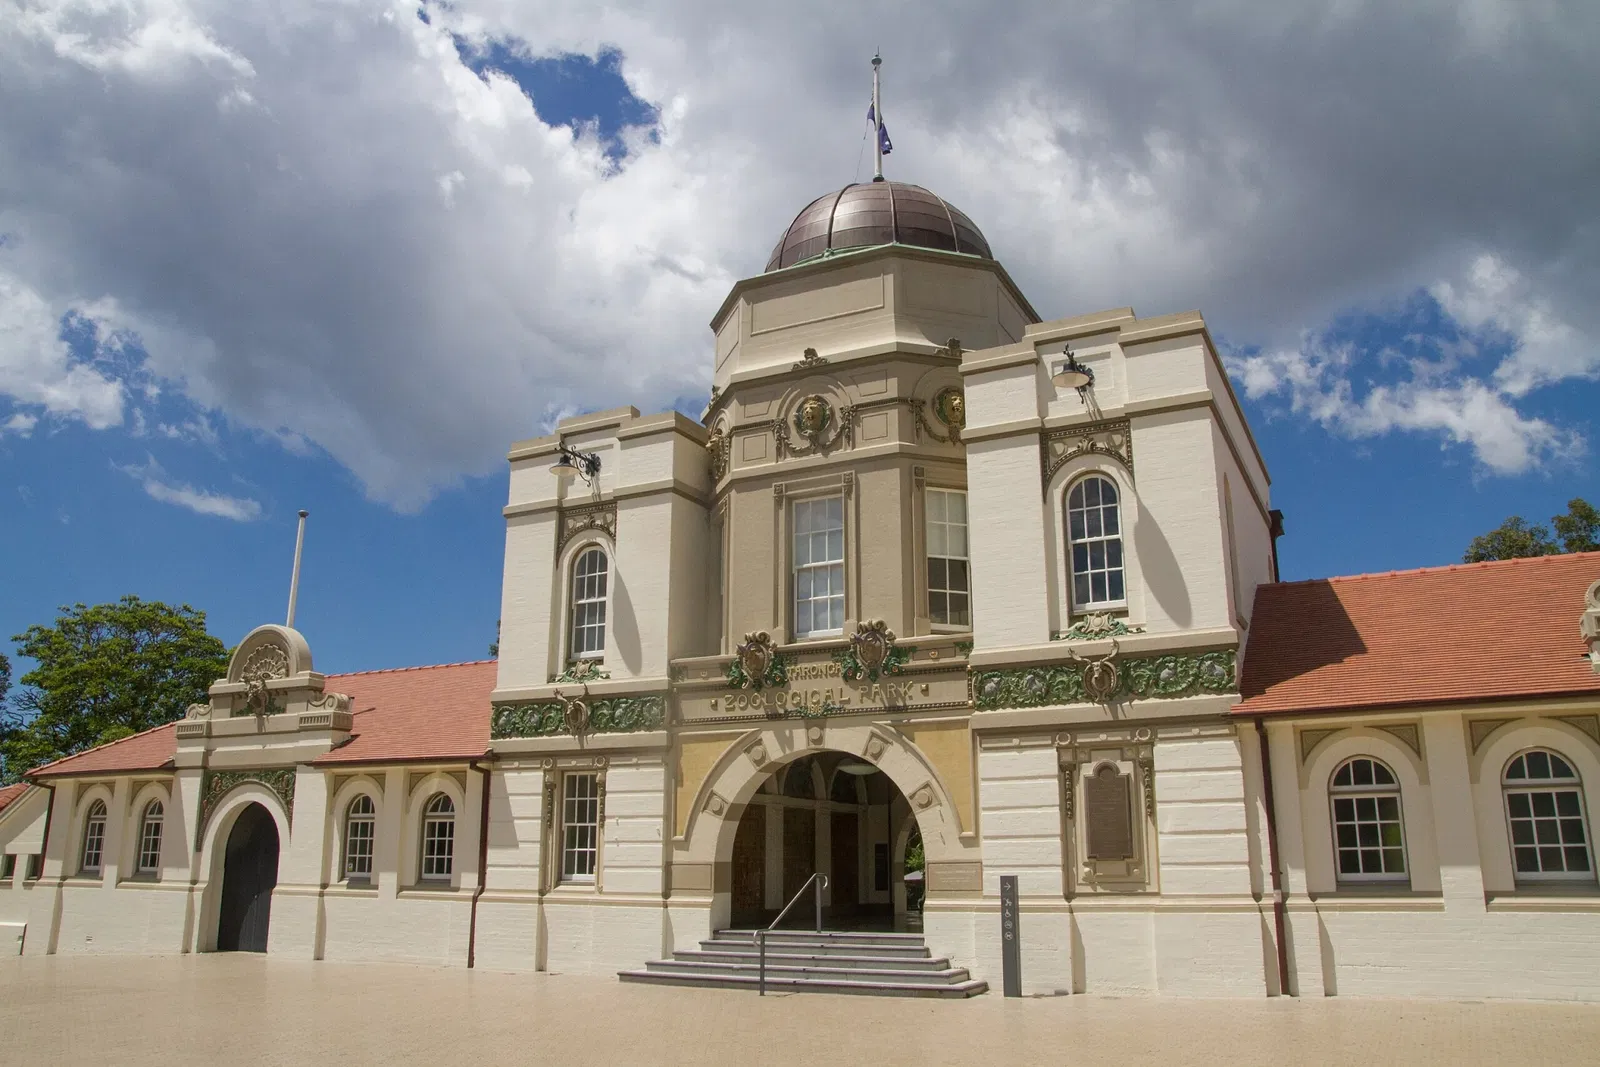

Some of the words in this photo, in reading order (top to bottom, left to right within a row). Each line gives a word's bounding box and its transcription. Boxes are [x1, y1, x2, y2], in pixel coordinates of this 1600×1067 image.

[786, 662, 841, 678] TARONGA
[723, 687, 850, 709] ZOOLOGICAL
[859, 681, 913, 701] PARK
